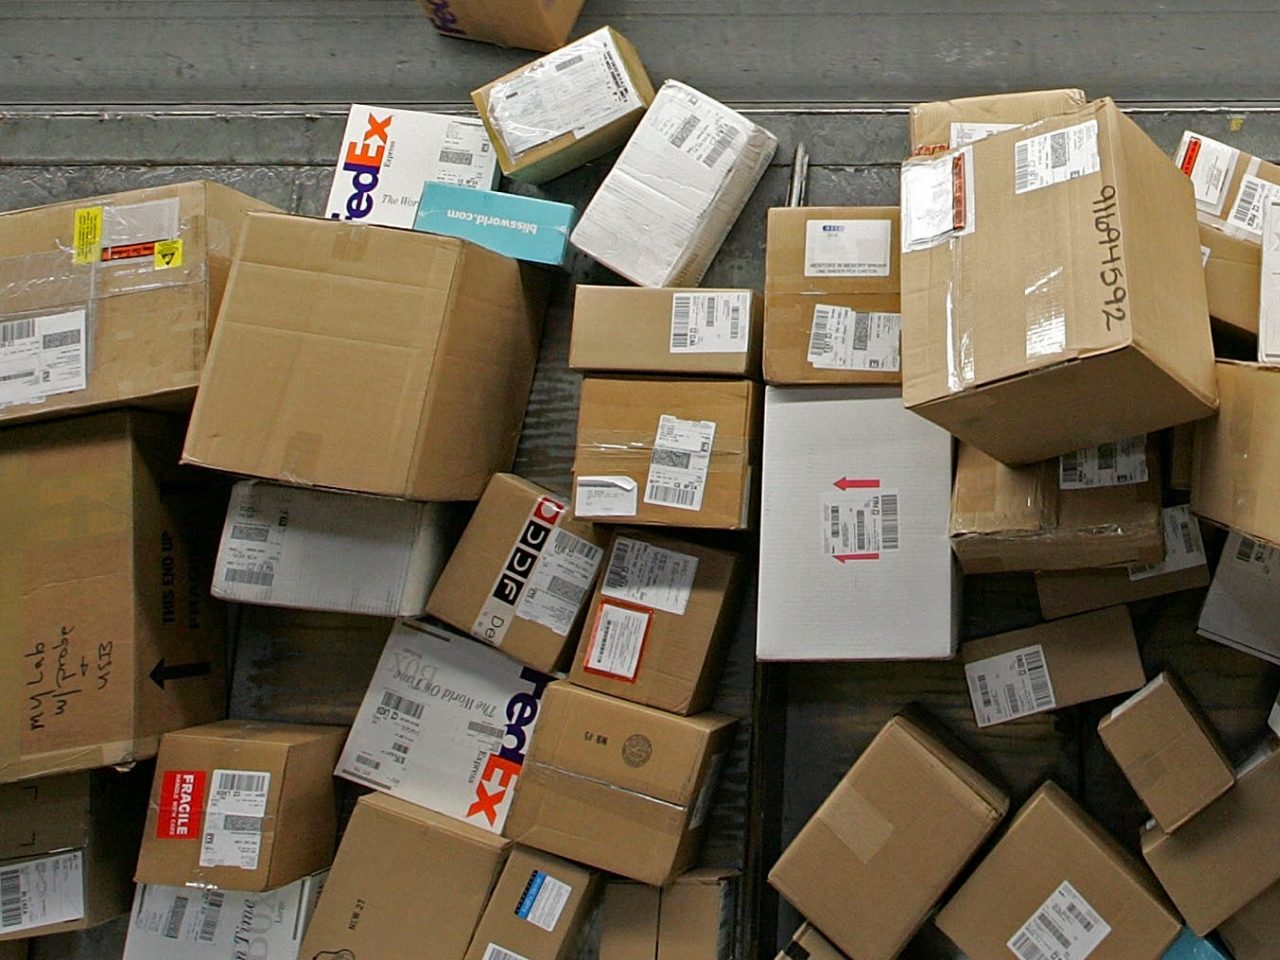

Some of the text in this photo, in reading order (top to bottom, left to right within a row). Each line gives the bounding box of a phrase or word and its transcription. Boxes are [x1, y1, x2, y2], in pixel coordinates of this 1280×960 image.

[383, 140, 397, 168] Express
[380, 193, 400, 209] The
[446, 208, 538, 236] blissworld.com
[161, 556, 175, 589] END
[161, 590, 176, 625] THIS
[391, 670, 498, 719] The World On Time
[465, 667, 556, 827] FedEx
[467, 748, 487, 785] Express
[176, 774, 194, 836] FRAGILE
